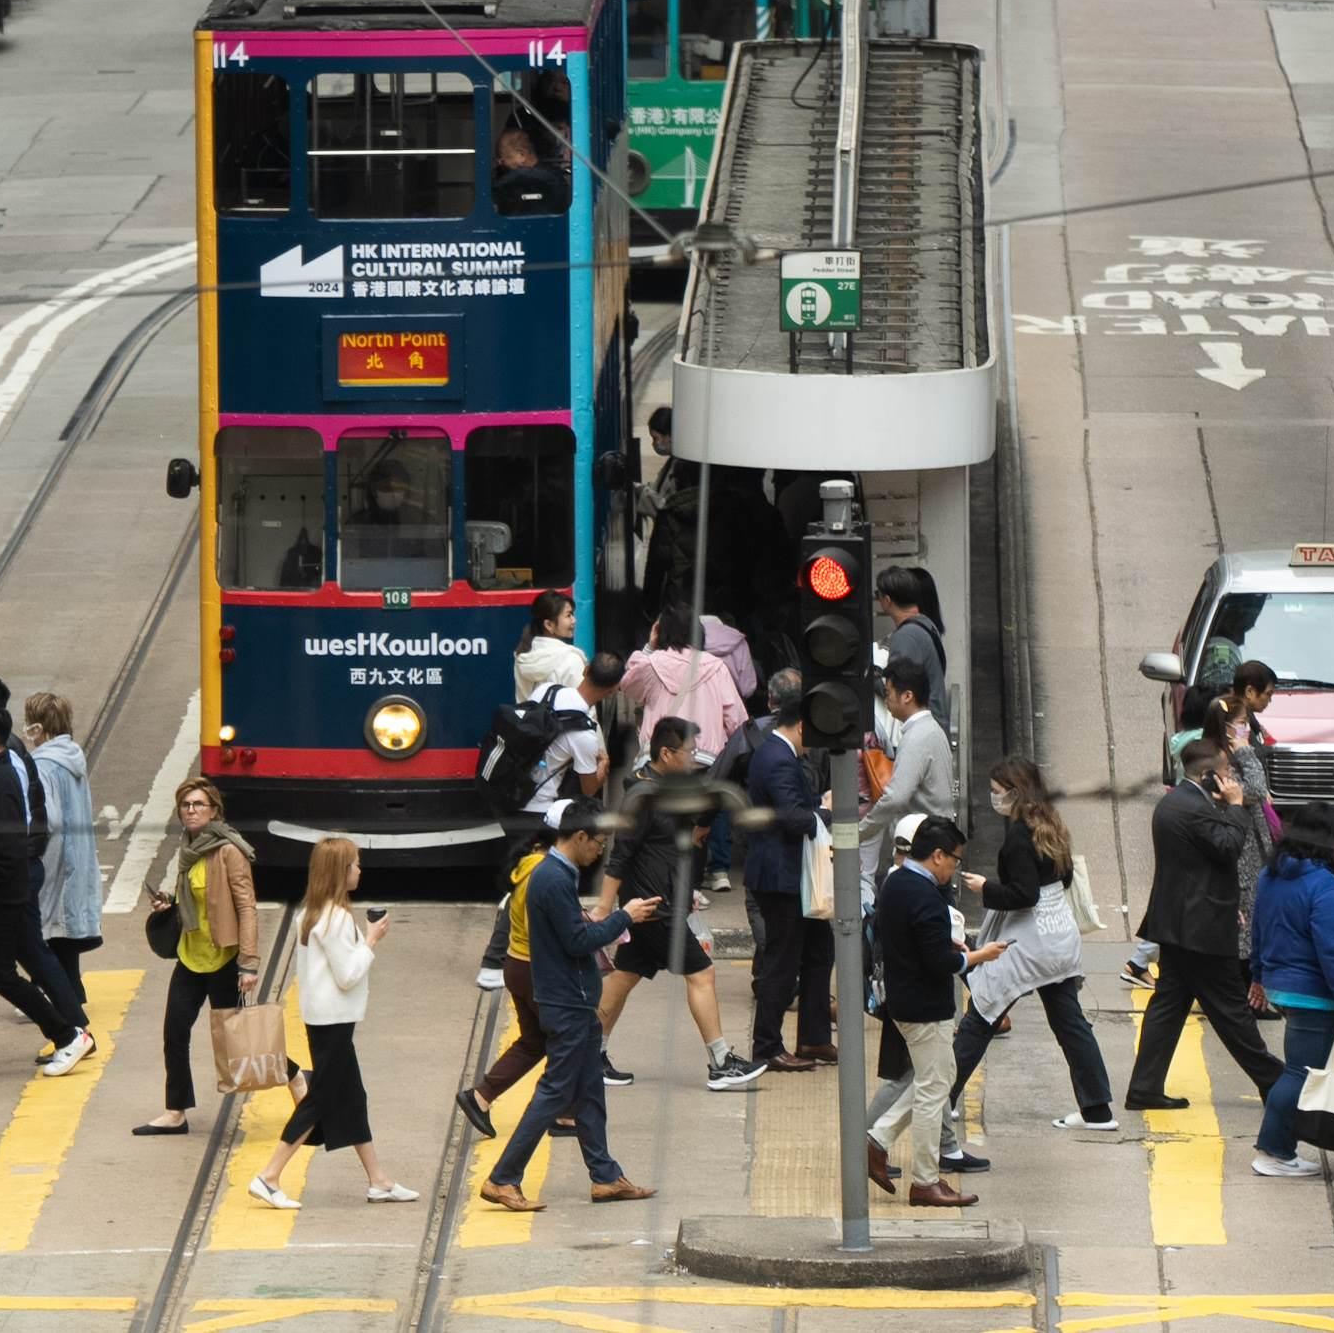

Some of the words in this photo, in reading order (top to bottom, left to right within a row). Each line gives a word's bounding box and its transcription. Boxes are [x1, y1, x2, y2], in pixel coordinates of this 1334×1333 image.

[213, 41, 250, 69] 114
[528, 39, 567, 67] 114
[351, 243, 378, 259] HK
[381, 241, 525, 259] INTERNATIONAL
[352, 261, 445, 278] CULTURAL
[451, 260, 525, 276] SUMMIT
[308, 282, 339, 293] 2024
[352, 278, 526, 298] 香港國際文化高峰論壇
[837, 281, 856, 291] 27E
[342, 332, 394, 348] North
[401, 332, 446, 348] Point
[385, 590, 409, 605] 108
[350, 667, 443, 686] 西九文化區
